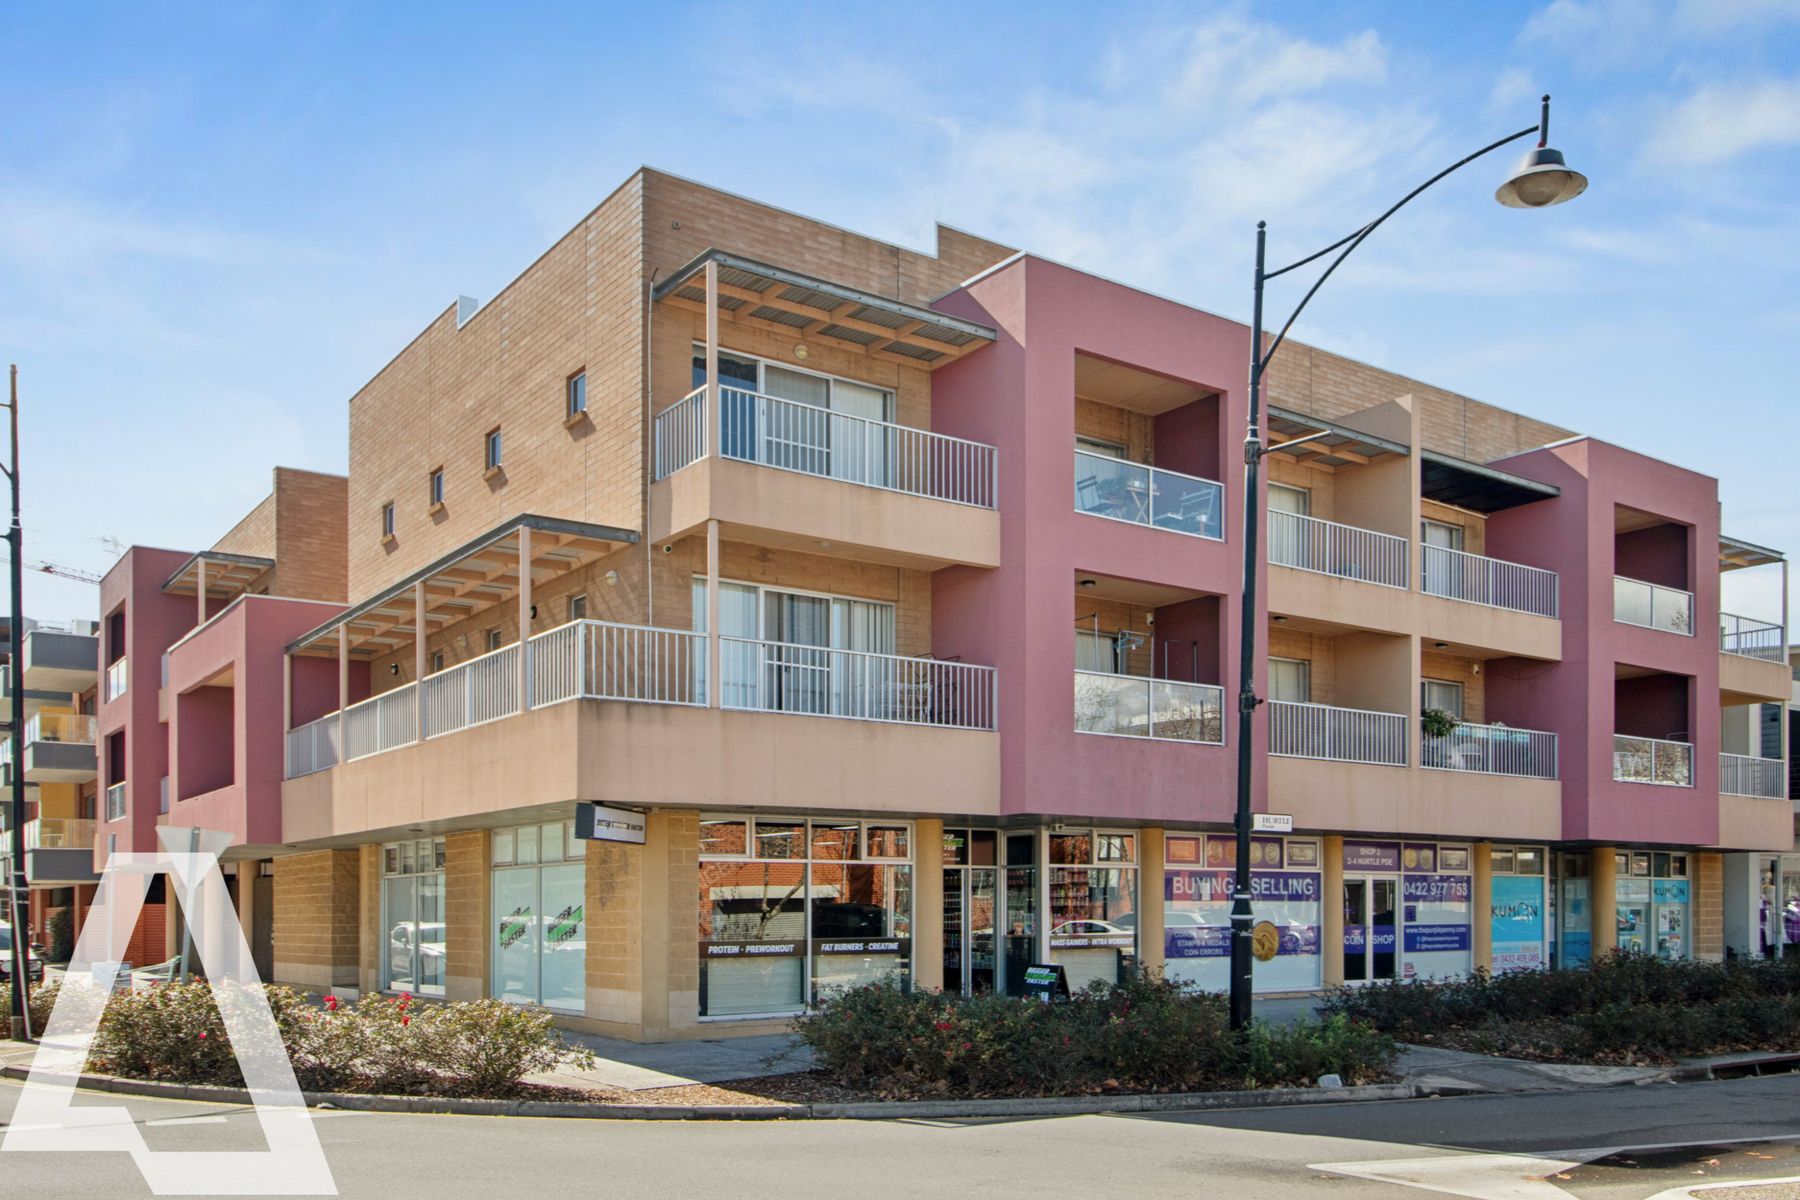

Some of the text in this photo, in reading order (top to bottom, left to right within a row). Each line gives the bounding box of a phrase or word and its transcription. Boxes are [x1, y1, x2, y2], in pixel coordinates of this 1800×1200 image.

[1262, 816, 1291, 825] HURTLE
[1360, 847, 1376, 855] SHOP
[1358, 857, 1380, 866] HURTLE
[1172, 876, 1313, 895] BUYING SELLING
[1404, 881, 1428, 896] 0422
[1430, 882, 1448, 897] 977
[1491, 902, 1538, 918] KUMON
[1343, 935, 1394, 945] COIN SHOP
[708, 944, 795, 954] PROTEIN PREWORKOUT
[833, 943, 864, 951] BURNERS
[868, 942, 899, 950] CREATINE
